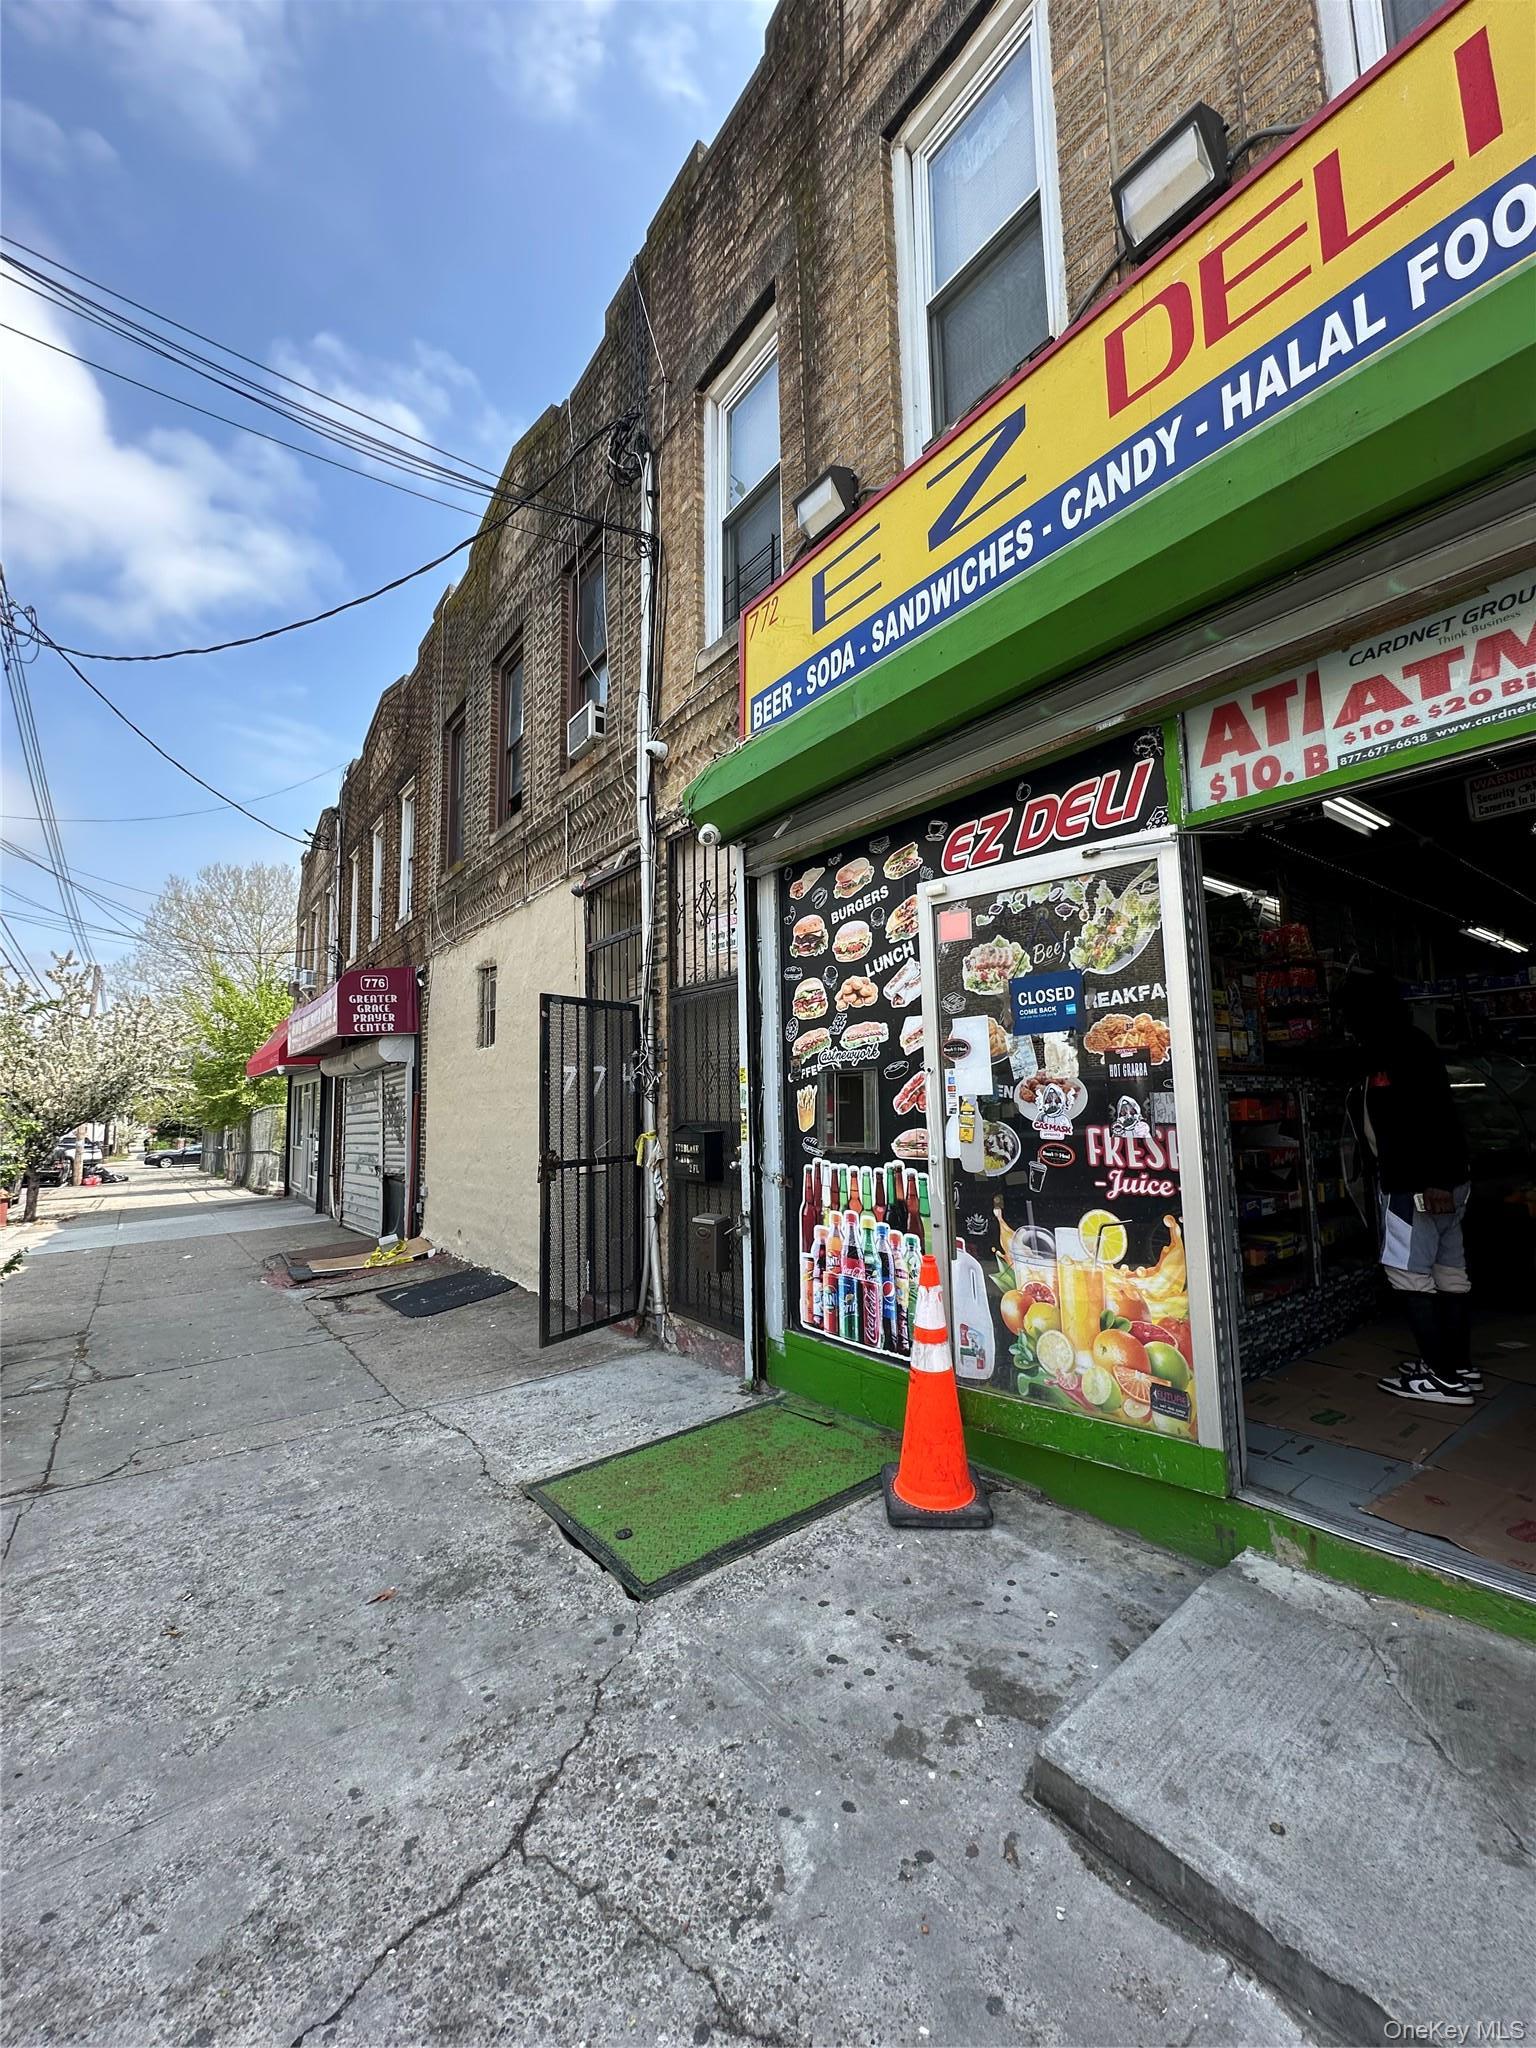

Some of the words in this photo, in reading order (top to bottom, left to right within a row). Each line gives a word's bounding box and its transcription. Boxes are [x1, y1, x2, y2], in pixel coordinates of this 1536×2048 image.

[1103, 25, 1504, 420] DELI
[753, 681, 793, 730] BEER
[806, 640, 855, 695] SODA
[871, 519, 1034, 653] SANDWICHES
[1060, 414, 1183, 531] CANDY
[1220, 292, 1387, 431] HALAL
[749, 595, 779, 641] 772
[1438, 630, 1467, 646] Think
[1472, 611, 1521, 634] Business
[1349, 615, 1456, 667] CARDNET
[1343, 719, 1395, 745] $10
[1401, 714, 1422, 728] &
[1428, 688, 1493, 719] $20
[1340, 732, 1428, 766] 877-677-6638
[941, 807, 1013, 875] EZ
[1013, 758, 1155, 856] DELI
[830, 885, 889, 924] BURGERS
[864, 940, 915, 978] LUNCH
[1033, 930, 1071, 965] Beef
[348, 994, 398, 1004] GREATER
[364, 978, 386, 988] 776
[1017, 986, 1075, 1006] CLOSED
[352, 1013, 395, 1023] PRAYER
[356, 1004, 391, 1013] GRACE
[1019, 1007, 1038, 1016] COME
[1039, 1005, 1057, 1014] BACK
[353, 1023, 395, 1032] CENTER
[1109, 1063, 1121, 1078] HOT
[1122, 1062, 1148, 1077] GRABBA
[1034, 1121, 1049, 1130] GAS
[1050, 1124, 1071, 1134] MASK
